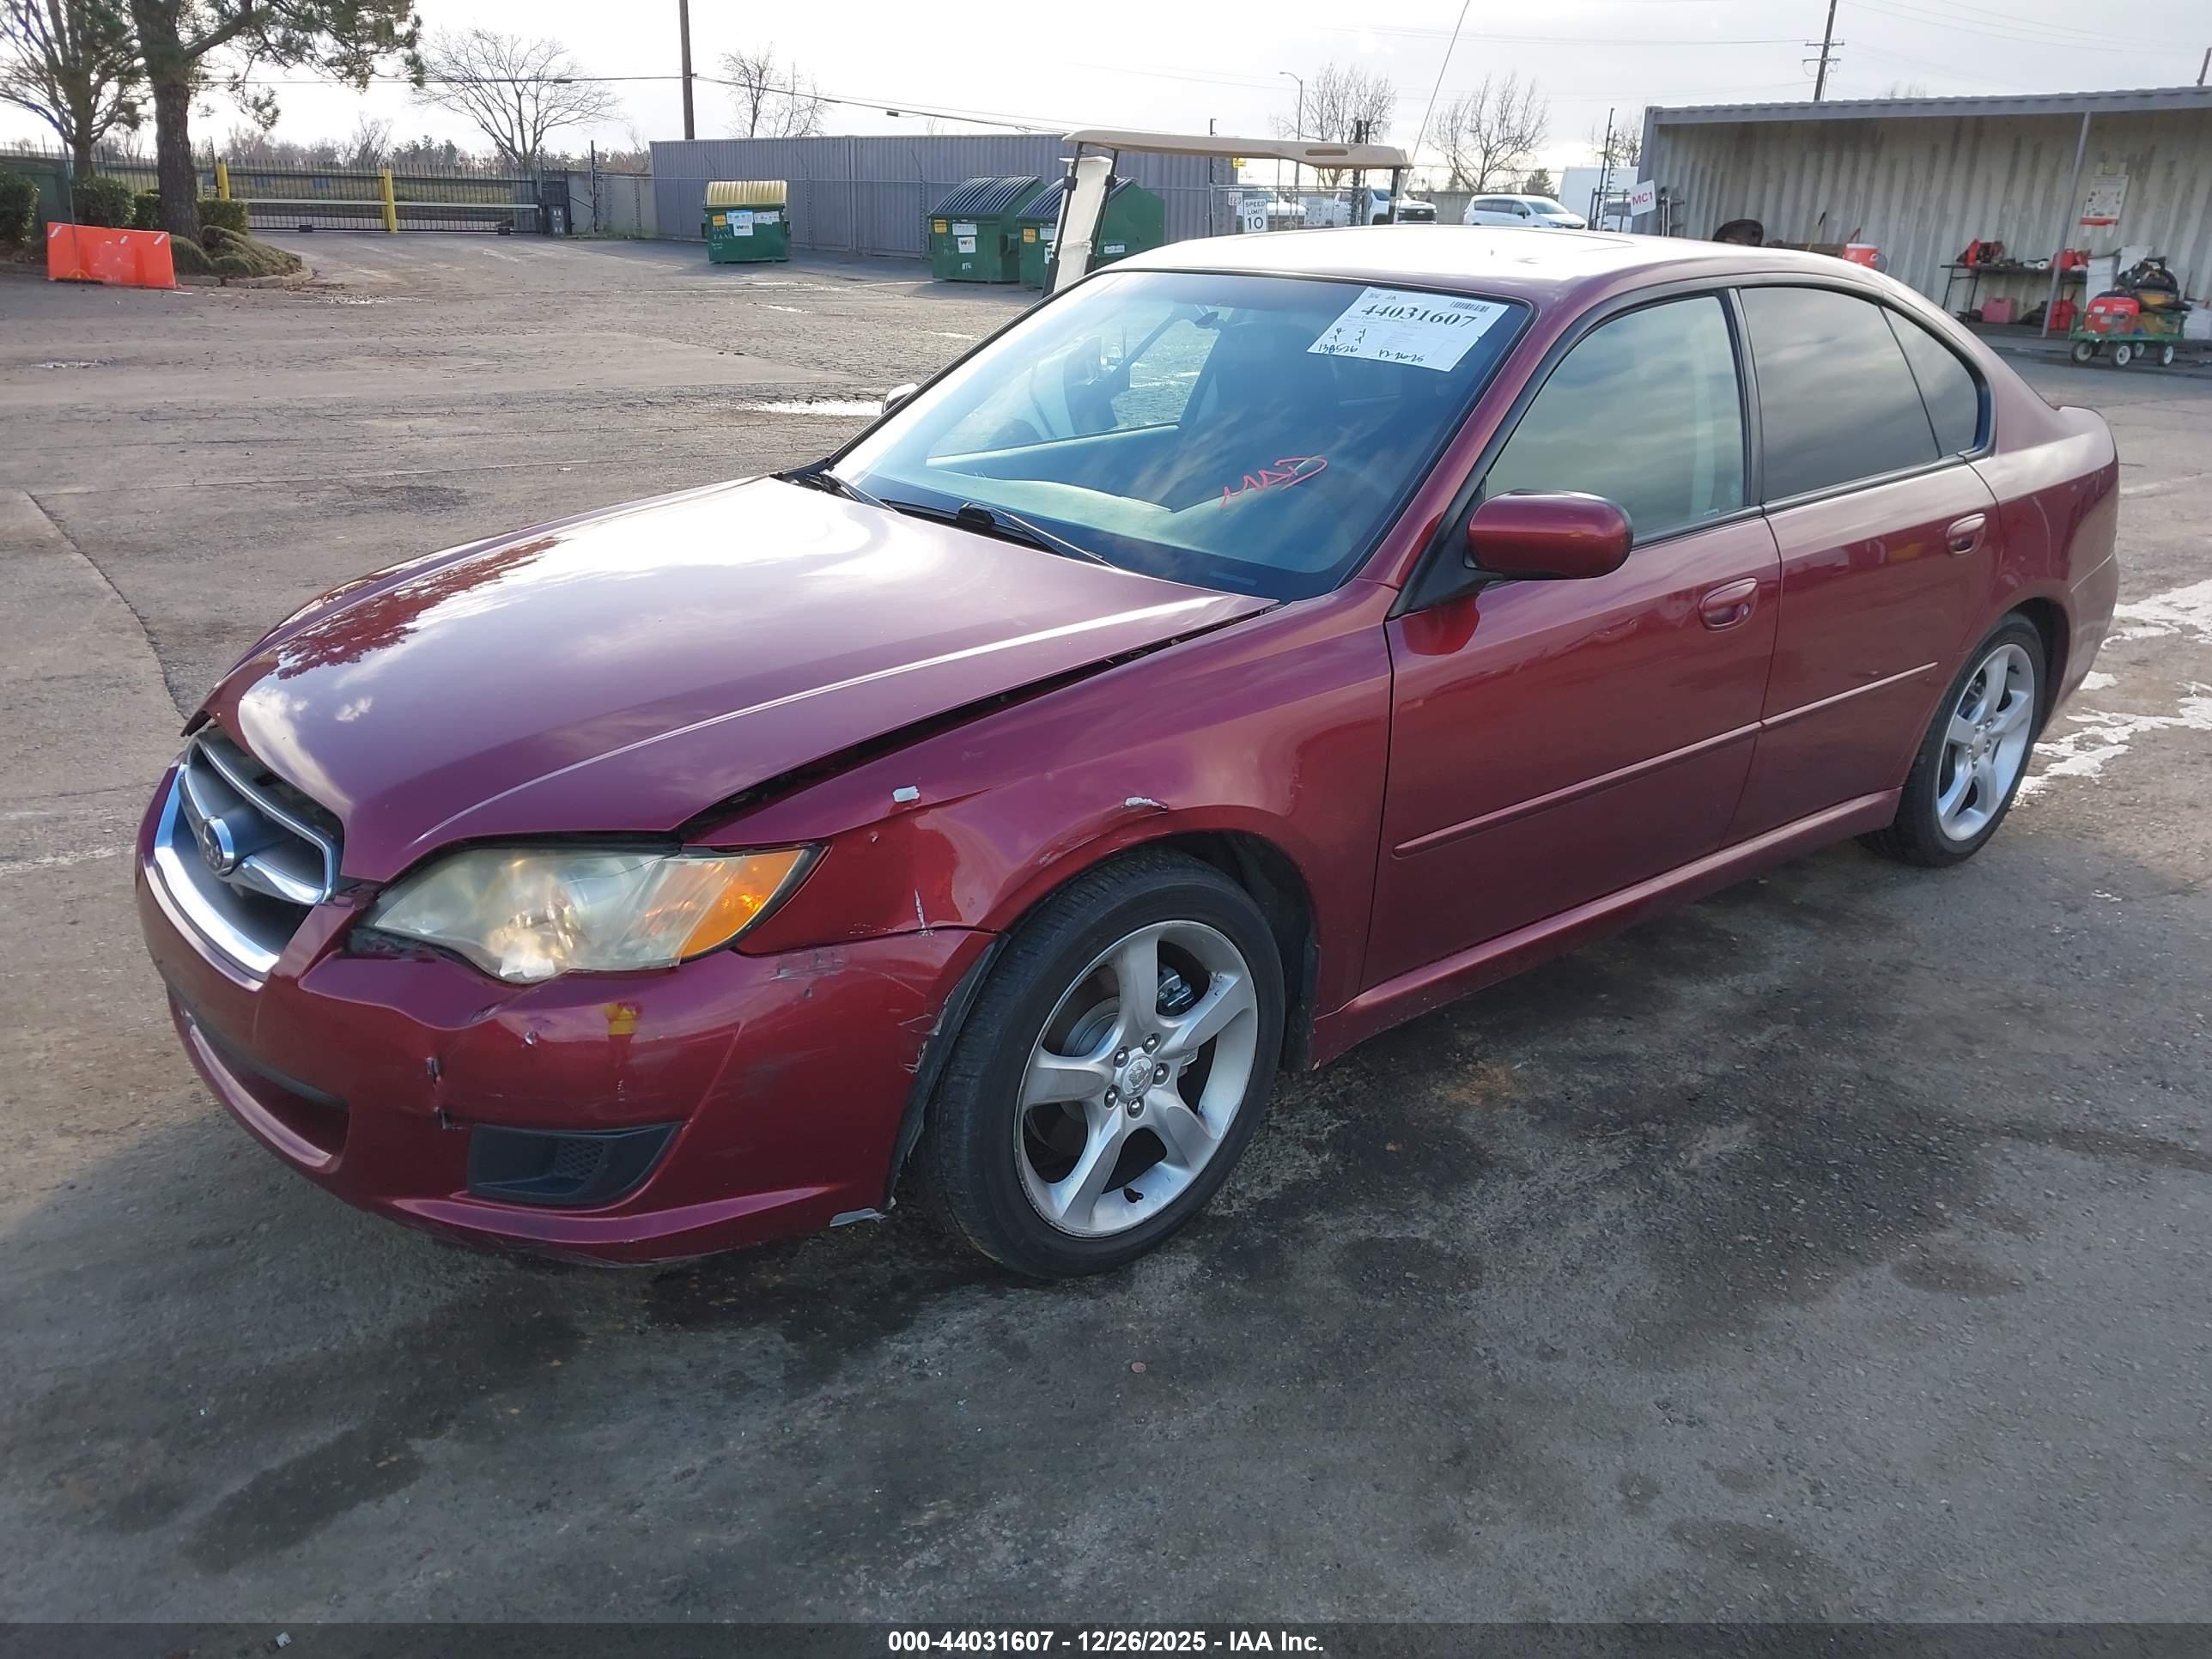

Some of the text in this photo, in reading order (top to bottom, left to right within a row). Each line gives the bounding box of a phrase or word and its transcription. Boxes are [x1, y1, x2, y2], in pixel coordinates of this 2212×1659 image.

[1632, 191, 1653, 206] MC1
[1247, 216, 1264, 229] 10
[1361, 304, 1477, 328] 44031607
